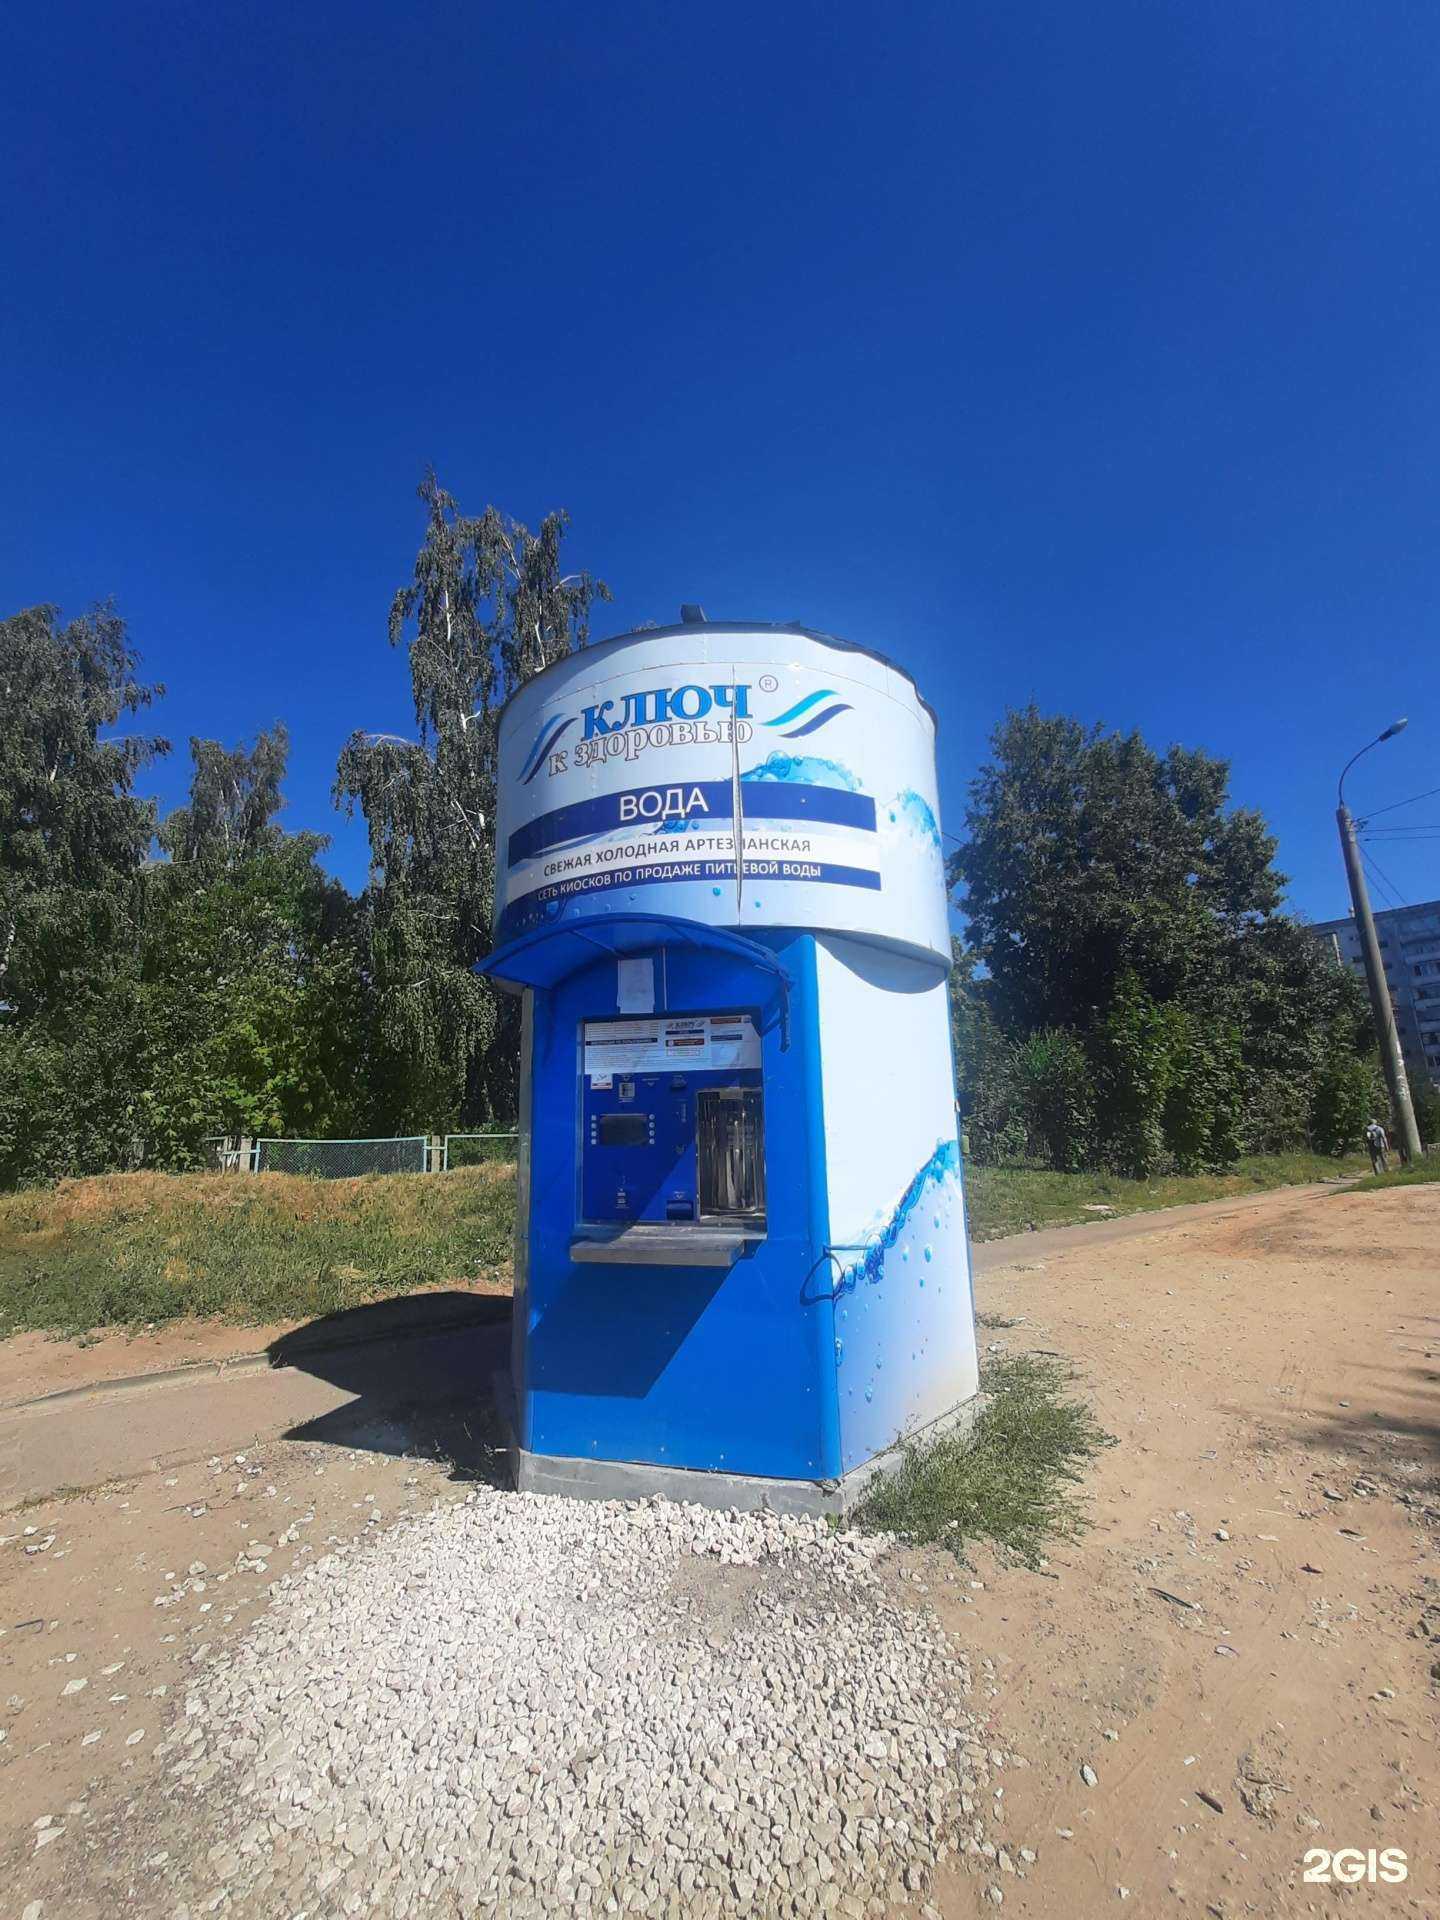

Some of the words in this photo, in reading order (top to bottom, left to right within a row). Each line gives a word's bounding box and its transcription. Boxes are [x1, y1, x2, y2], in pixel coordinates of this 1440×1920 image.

[619, 787, 710, 821] ВОДА
[543, 853, 592, 877] СВЕЖАЯ
[595, 840, 680, 863] ХОЛОДНАЯ
[538, 885, 558, 901] СЕТЬ
[560, 874, 611, 894] КИОСКОВ
[614, 870, 632, 882] ПО
[635, 863, 701, 880] ПРОДАЖЕ
[783, 864, 821, 878] ВОДЫ
